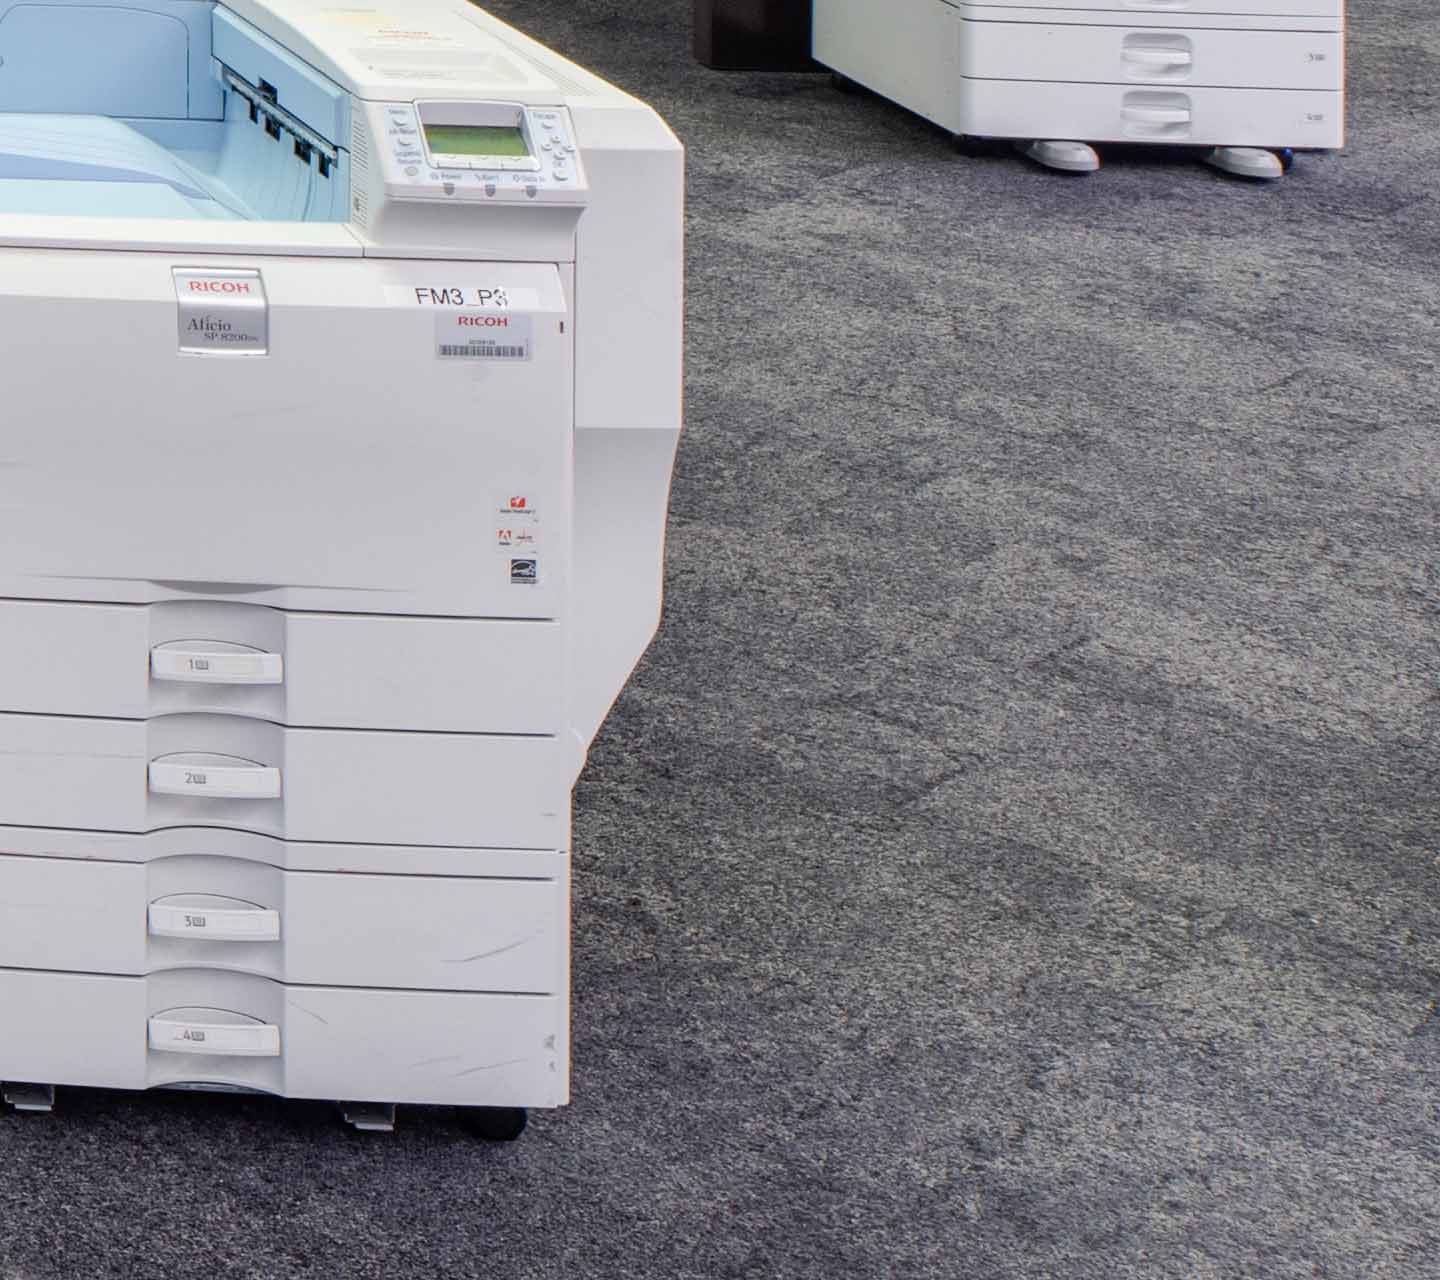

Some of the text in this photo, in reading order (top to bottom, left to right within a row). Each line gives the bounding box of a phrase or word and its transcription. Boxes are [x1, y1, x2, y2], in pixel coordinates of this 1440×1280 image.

[188, 280, 250, 293] RICOH
[187, 314, 222, 332] Aficio
[457, 315, 509, 327] RICOH
